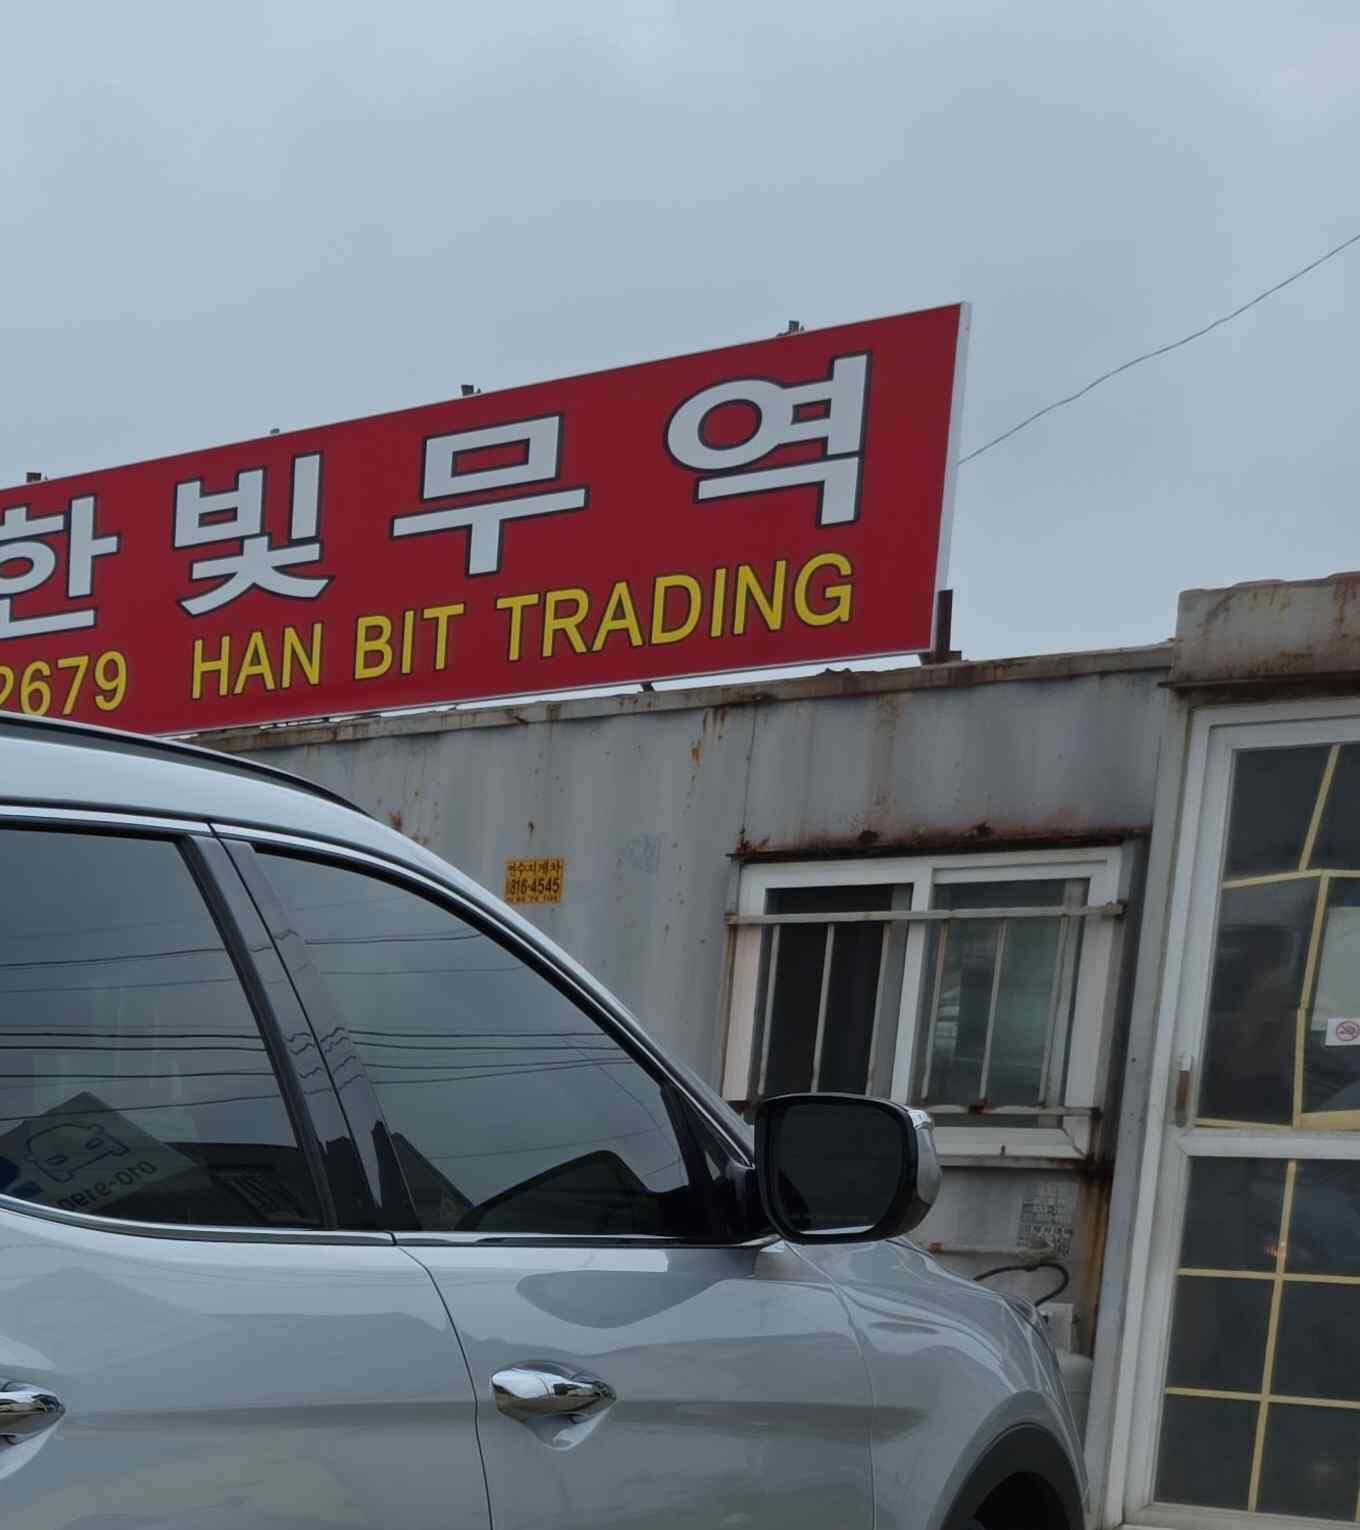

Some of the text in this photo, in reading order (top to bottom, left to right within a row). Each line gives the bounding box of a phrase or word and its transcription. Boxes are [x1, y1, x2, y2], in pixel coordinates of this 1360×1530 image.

[191, 622, 323, 699] HAN
[353, 603, 465, 680] BIT
[495, 552, 853, 661] TRADING
